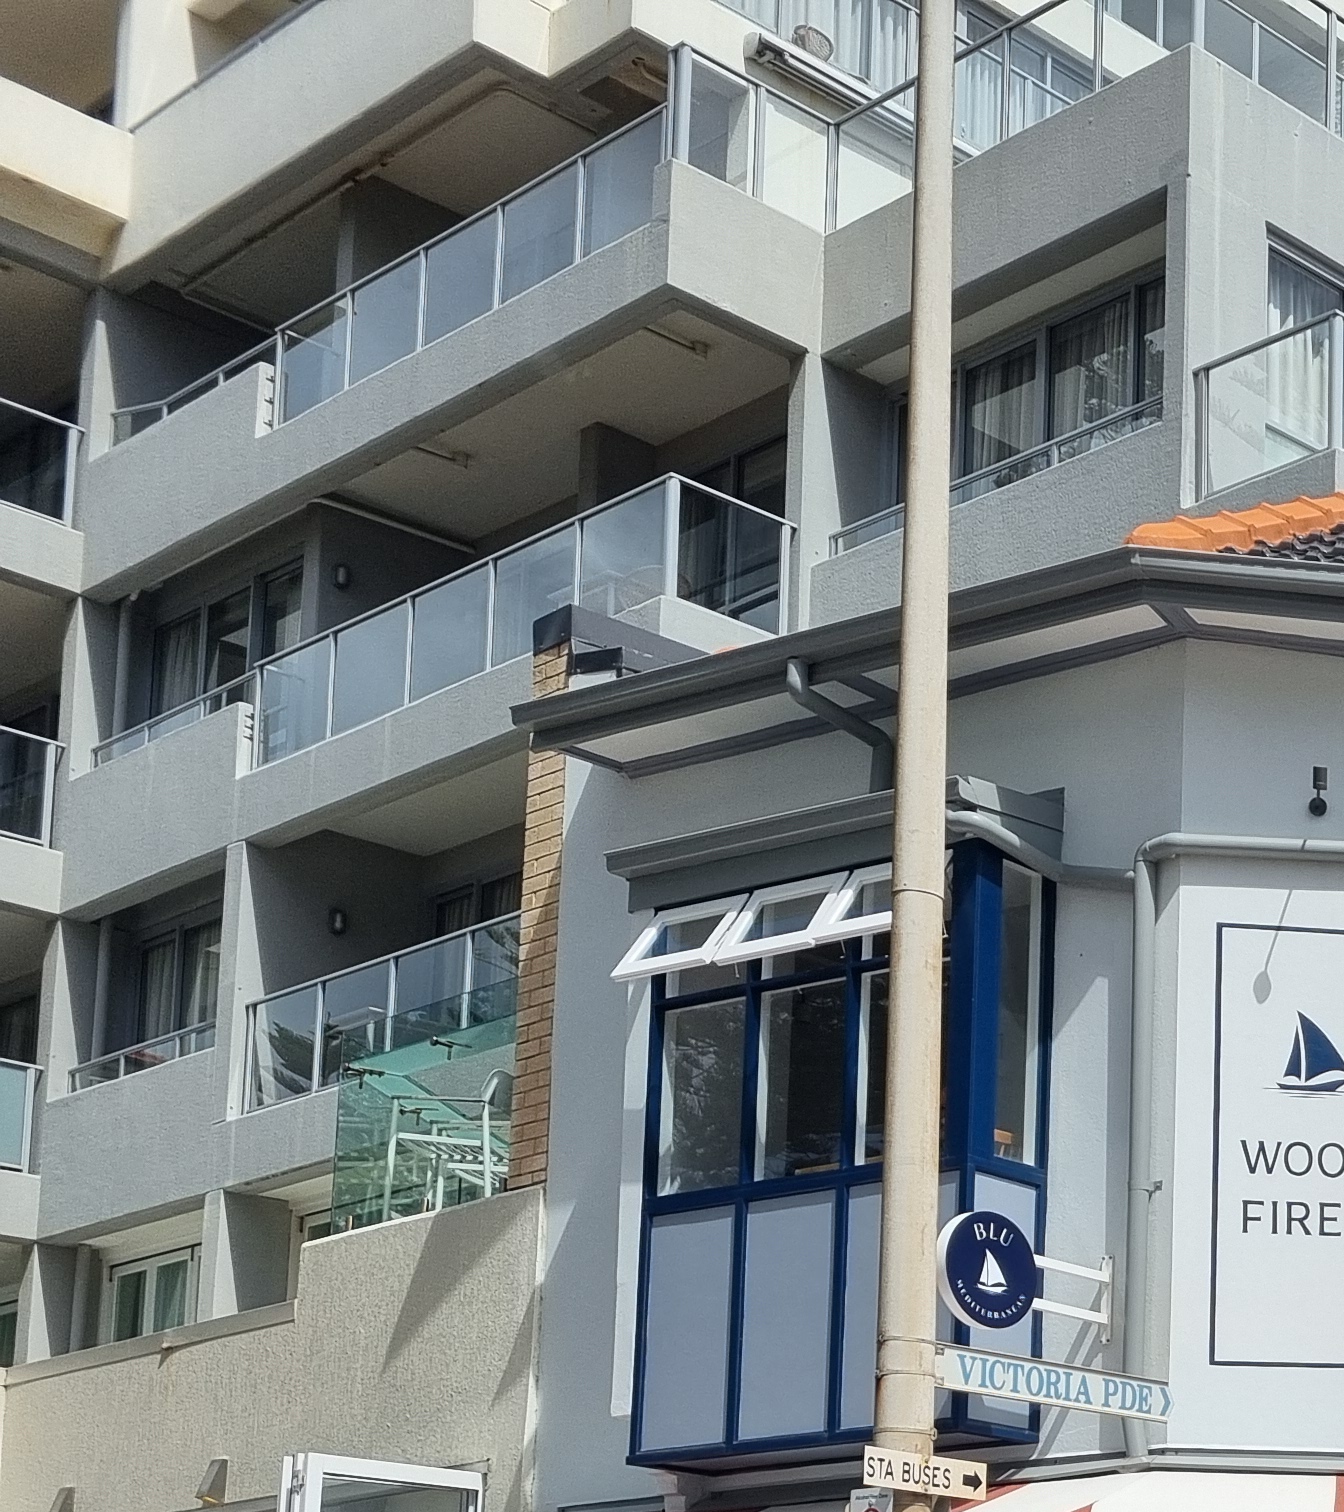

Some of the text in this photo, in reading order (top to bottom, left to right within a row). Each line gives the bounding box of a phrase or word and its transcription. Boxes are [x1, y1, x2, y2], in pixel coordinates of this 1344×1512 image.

[973, 1221, 1015, 1247] BLU
[955, 1278, 1028, 1320] MEDITERRANEAN
[957, 1354, 1153, 1414] VICTORIA PDE
[866, 1456, 951, 1490] STA BUSES
